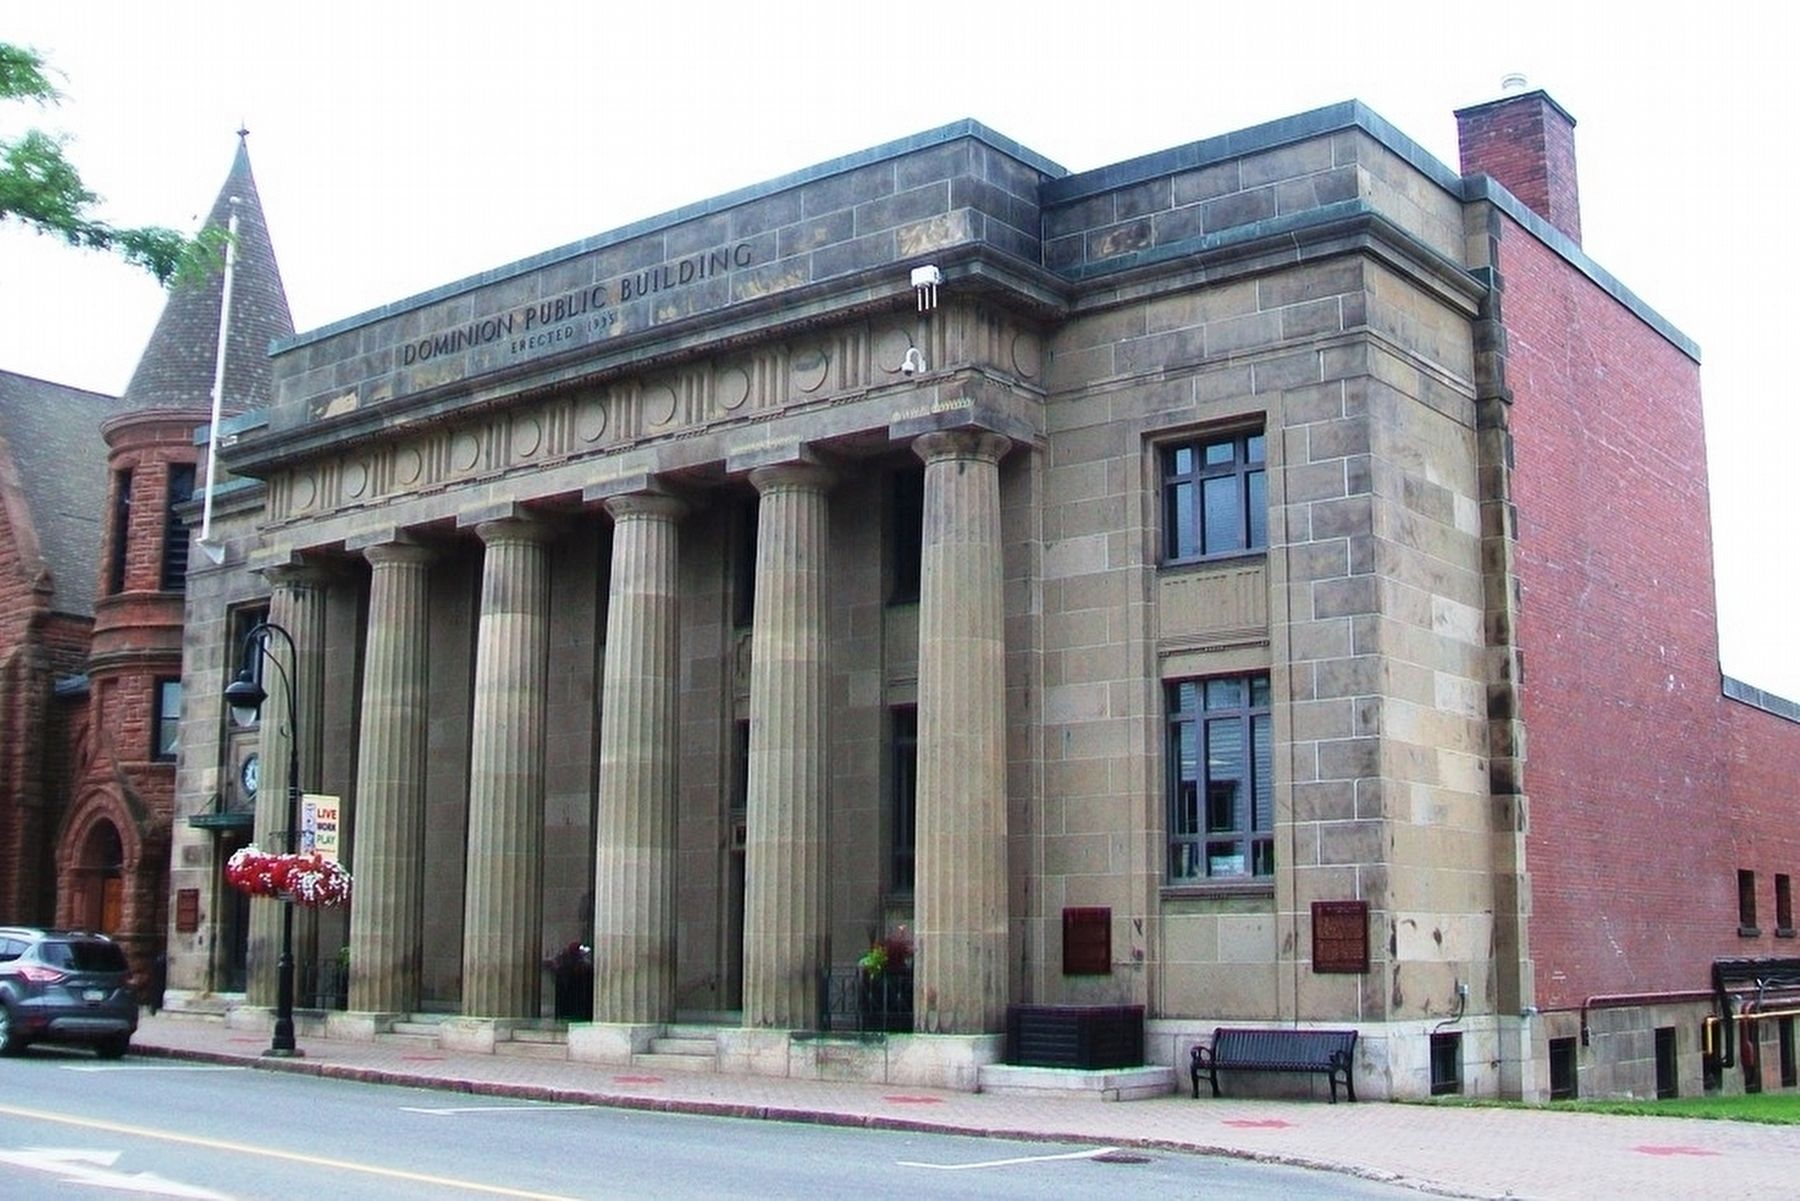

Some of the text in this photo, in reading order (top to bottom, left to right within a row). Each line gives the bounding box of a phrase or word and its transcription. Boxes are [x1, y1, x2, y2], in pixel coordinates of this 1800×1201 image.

[404, 244, 751, 366] DOMINION PUBLIC BUILDING
[511, 325, 574, 354] ERECTED
[317, 808, 337, 820] LIVE
[317, 833, 336, 845] PLAY
